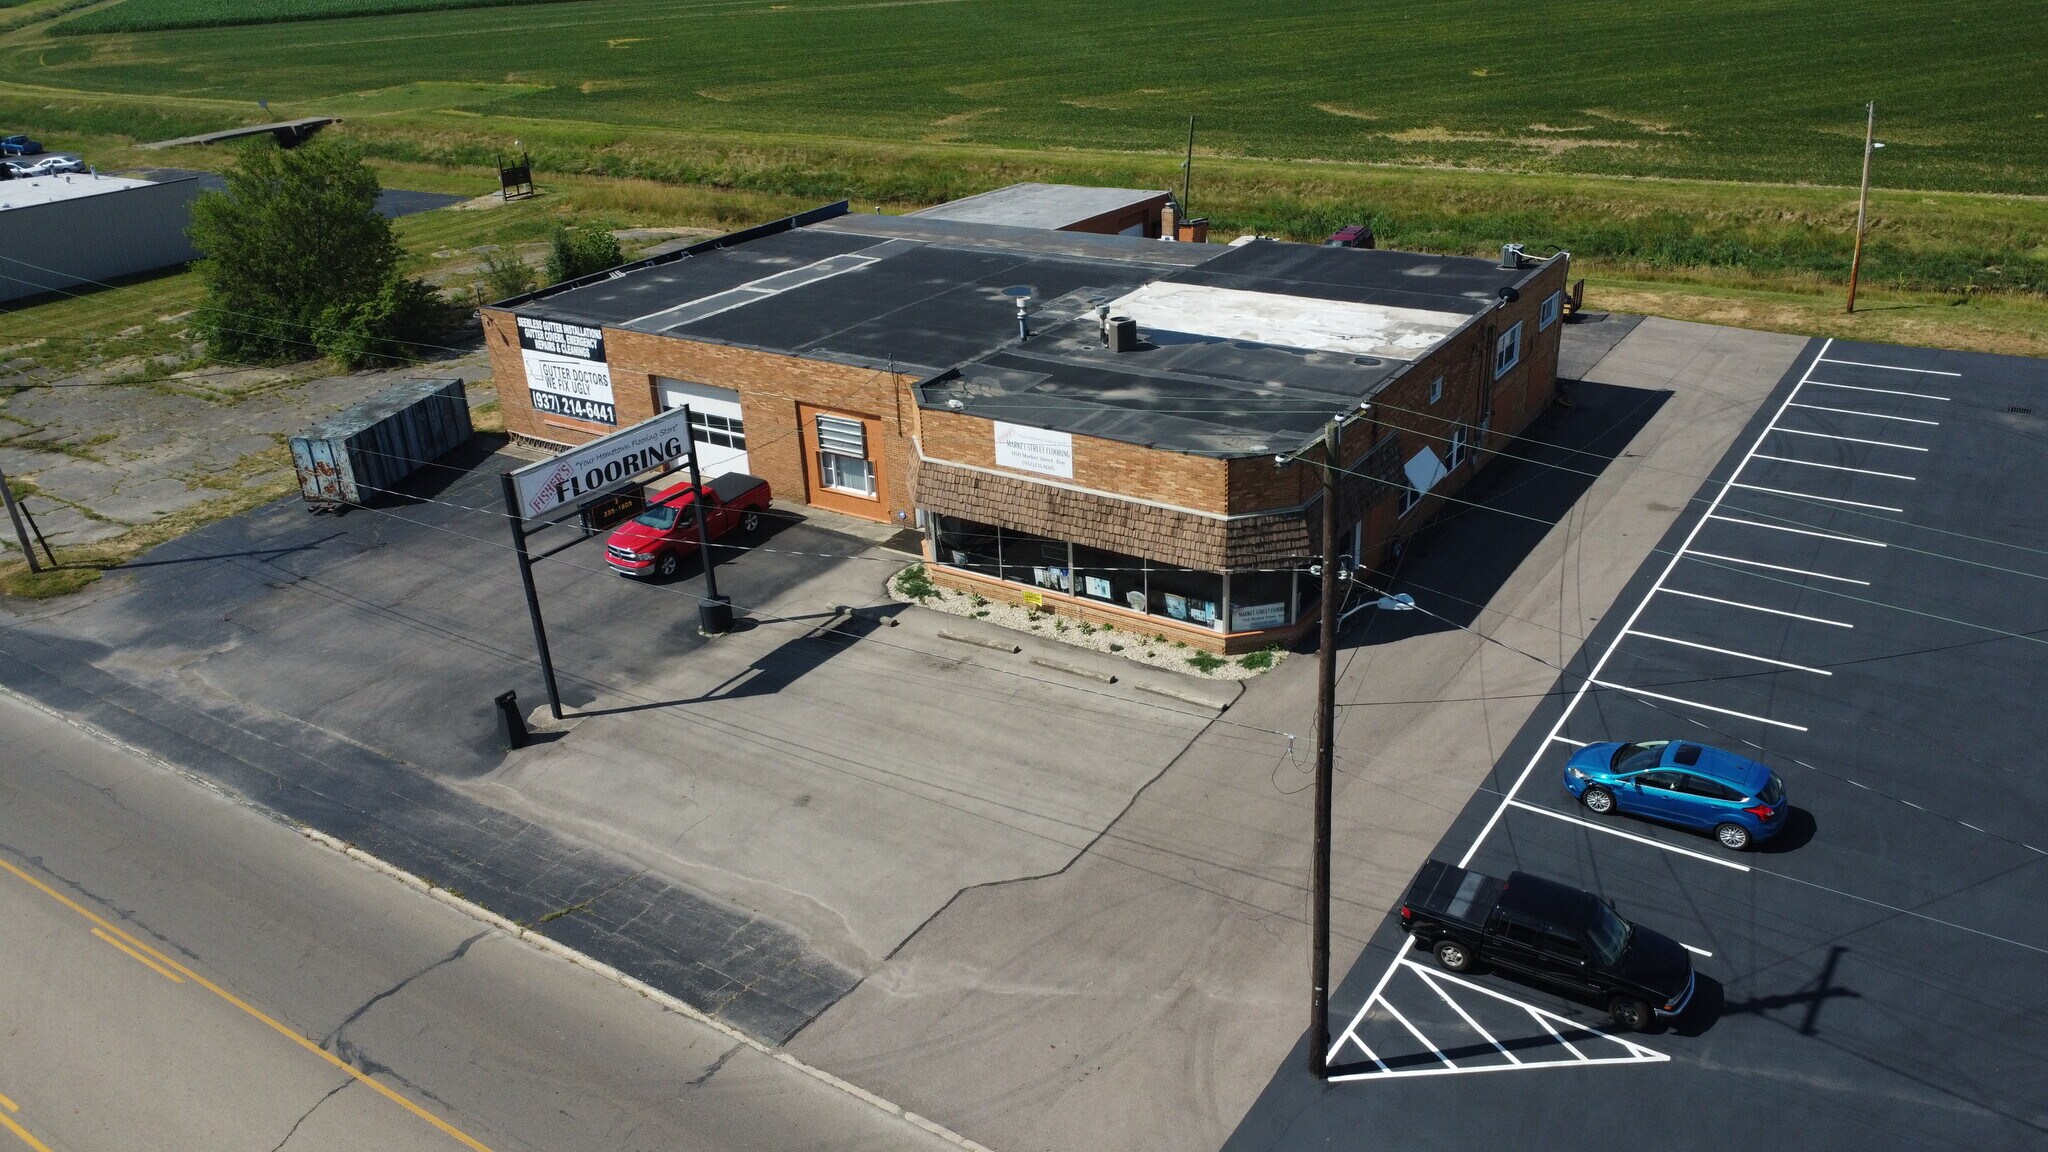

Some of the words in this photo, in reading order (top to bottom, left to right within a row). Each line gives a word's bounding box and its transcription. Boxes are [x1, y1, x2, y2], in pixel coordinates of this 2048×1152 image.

[525, 328, 545, 340] GUTTER
[566, 335, 598, 349] EMERGENCY
[543, 321, 563, 334] GUTTER
[563, 324, 602, 340] INSTALLATIONS
[534, 339, 556, 352] REPAIRS
[556, 343, 561, 353] &
[561, 344, 590, 358] CLEANINGS
[543, 364, 571, 380] GUTTER
[572, 369, 609, 387] DOCTORS
[545, 376, 557, 390] WE
[558, 379, 570, 392] FIX
[571, 382, 591, 396] UGLY
[532, 390, 560, 413] (937)
[562, 397, 614, 422] 214-6441
[596, 444, 631, 464] Hometown
[631, 432, 659, 449] Flooring
[1006, 440, 1026, 451] MARKET
[1027, 443, 1045, 454] STREET
[1045, 447, 1070, 458] FLOORING
[556, 437, 682, 503] FLOORING
[532, 463, 572, 513] FISHER'S
